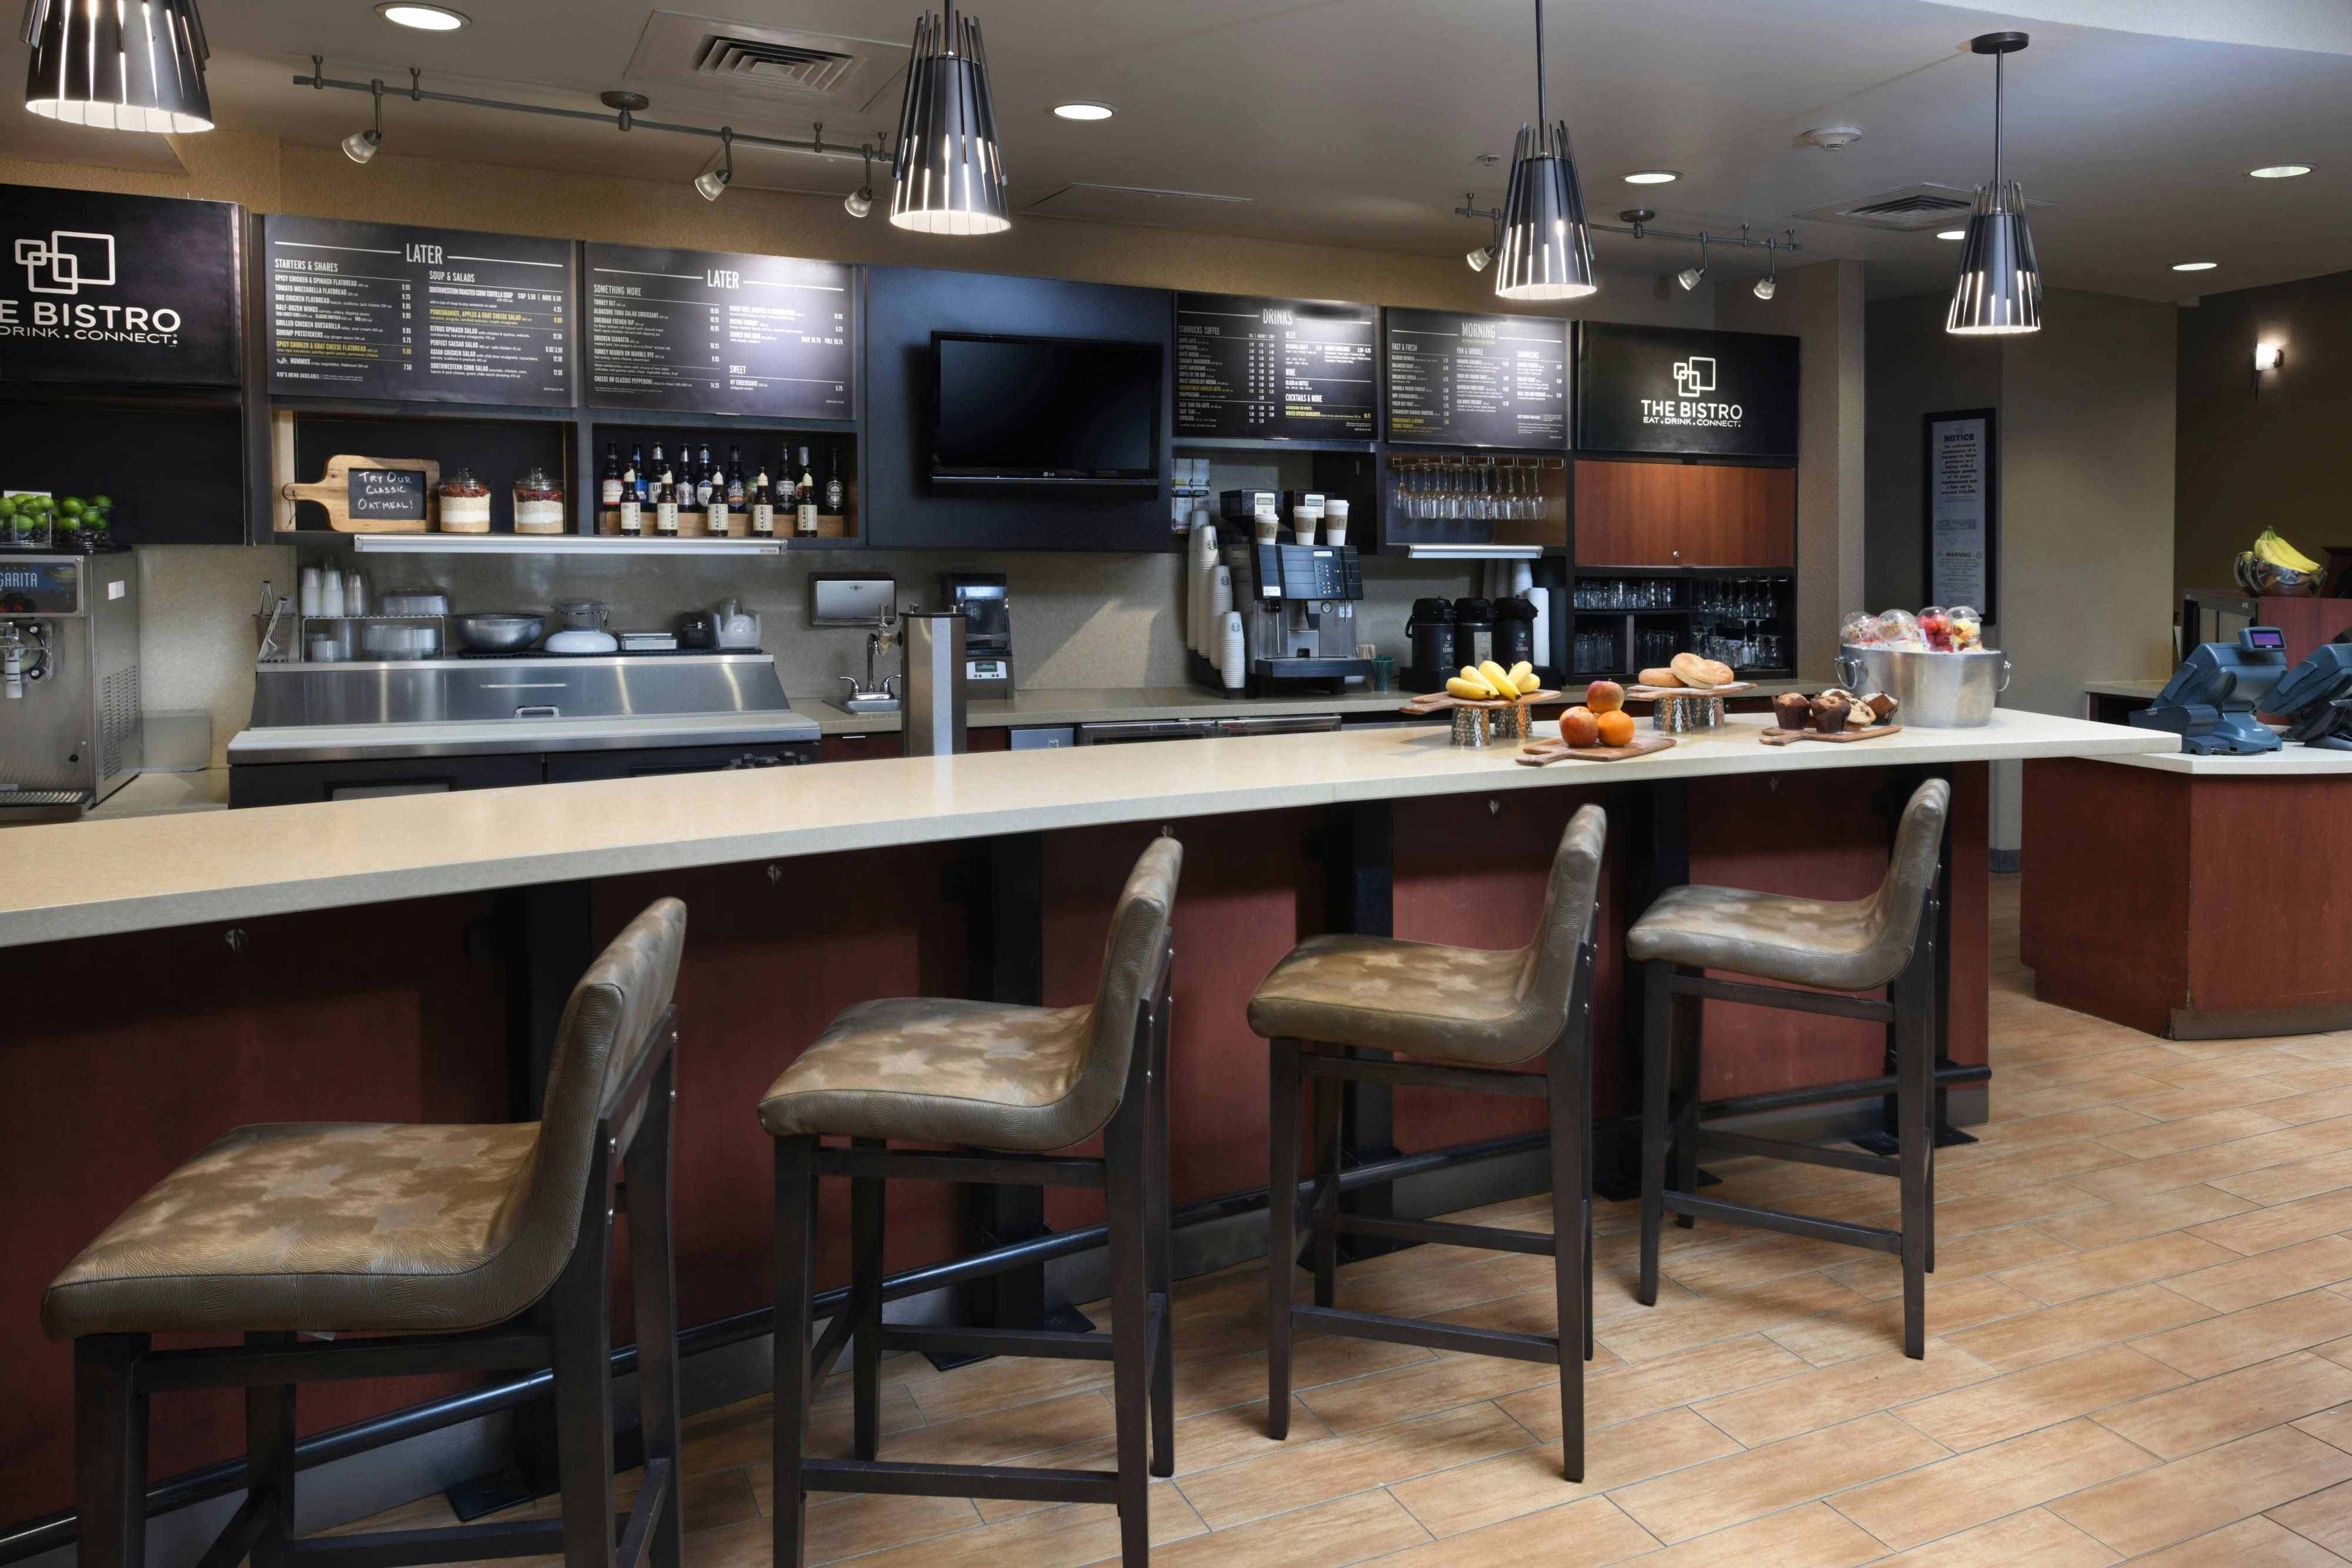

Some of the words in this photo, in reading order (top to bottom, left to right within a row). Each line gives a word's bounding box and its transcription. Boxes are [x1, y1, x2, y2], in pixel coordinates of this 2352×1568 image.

[407, 243, 442, 265] LATER
[275, 259, 306, 270] STARTERS
[308, 261, 312, 270] &
[315, 262, 338, 272] SHARES
[429, 271, 445, 280] SOUP
[447, 272, 450, 280] &
[453, 272, 475, 282] SALADS
[707, 269, 739, 289] LATER
[429, 286, 458, 295] SOUTHWESTERN
[594, 284, 624, 295] SOMETHING
[627, 287, 642, 296] MORE
[34, 302, 181, 332] BISTRO
[430, 309, 461, 317] POMEGRANATE,
[1263, 308, 1292, 325] DRINKS
[1179, 325, 1202, 334] STARBUCKS
[1462, 323, 1495, 339] MORNING
[730, 365, 746, 374] SWEET
[1641, 400, 1675, 417] THE
[1681, 402, 1742, 419] BISTRO
[1945, 433, 1974, 442] NOTICE
[0, 573, 37, 587] GARITA
